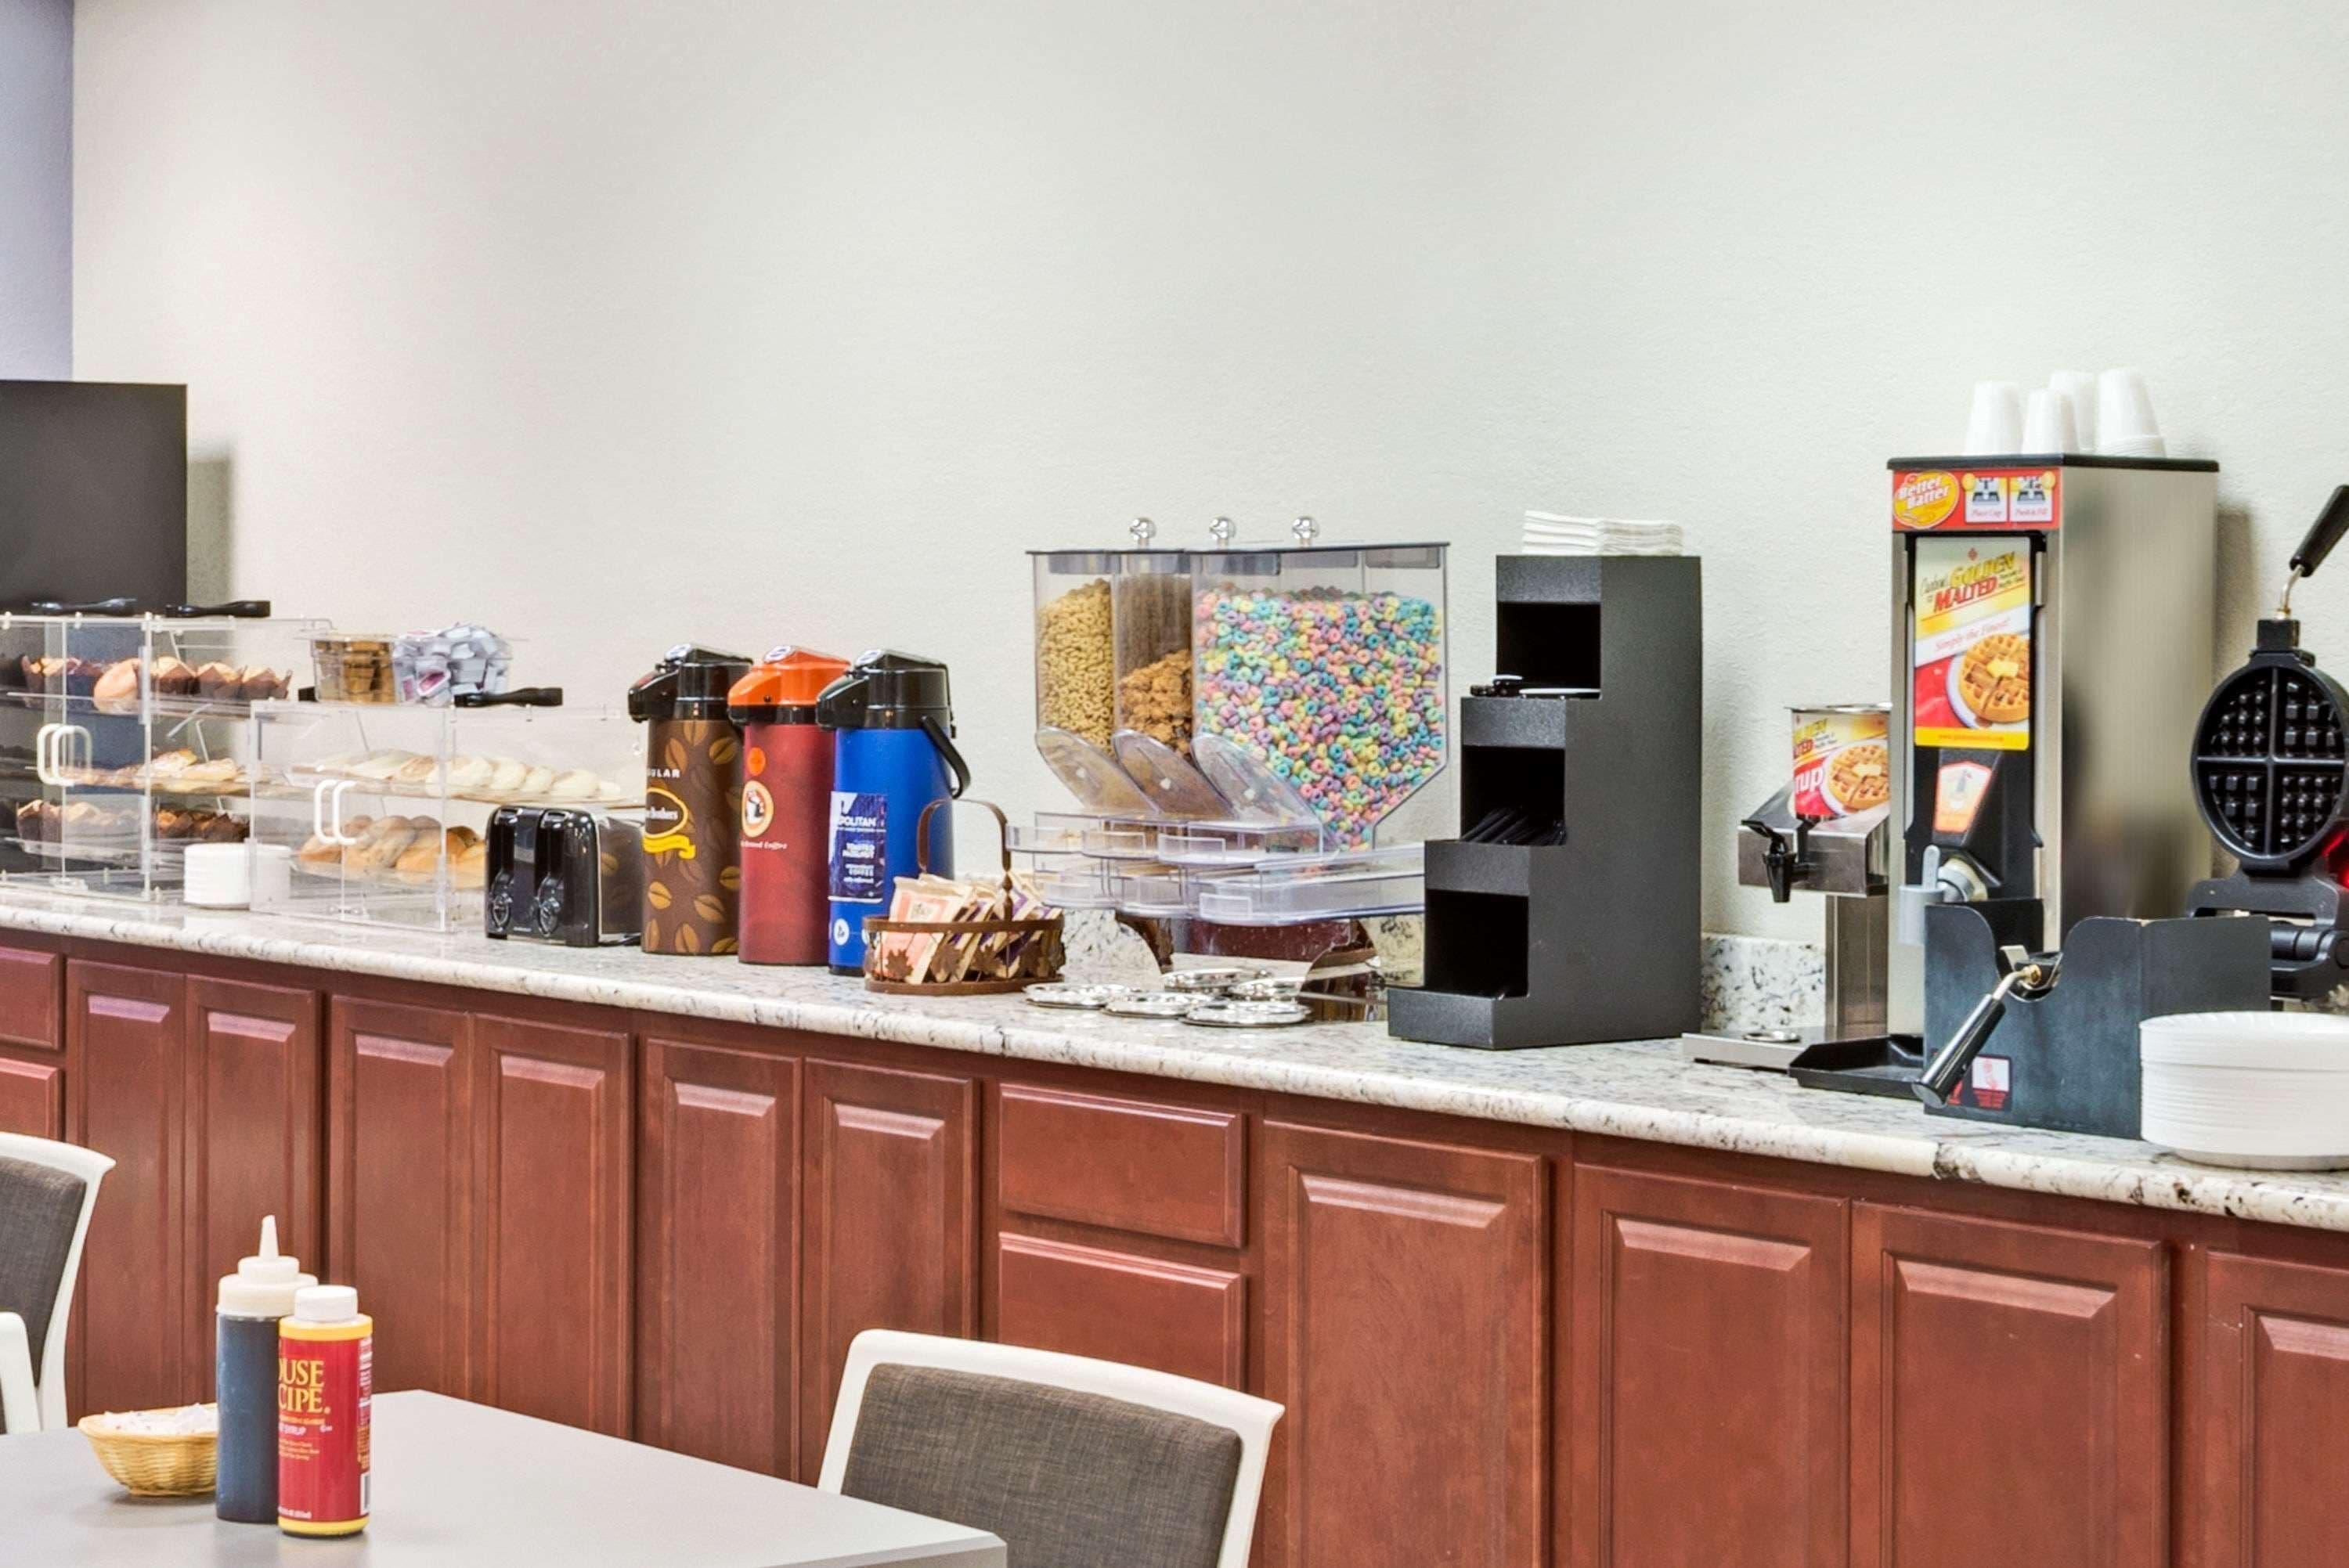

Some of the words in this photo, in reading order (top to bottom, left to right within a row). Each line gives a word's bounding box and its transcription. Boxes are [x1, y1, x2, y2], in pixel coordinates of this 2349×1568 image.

[1899, 476, 1943, 499] Better
[1907, 486, 1950, 510] Batter
[1950, 551, 2015, 589] GOLDEN
[1933, 576, 1997, 613] MALTED
